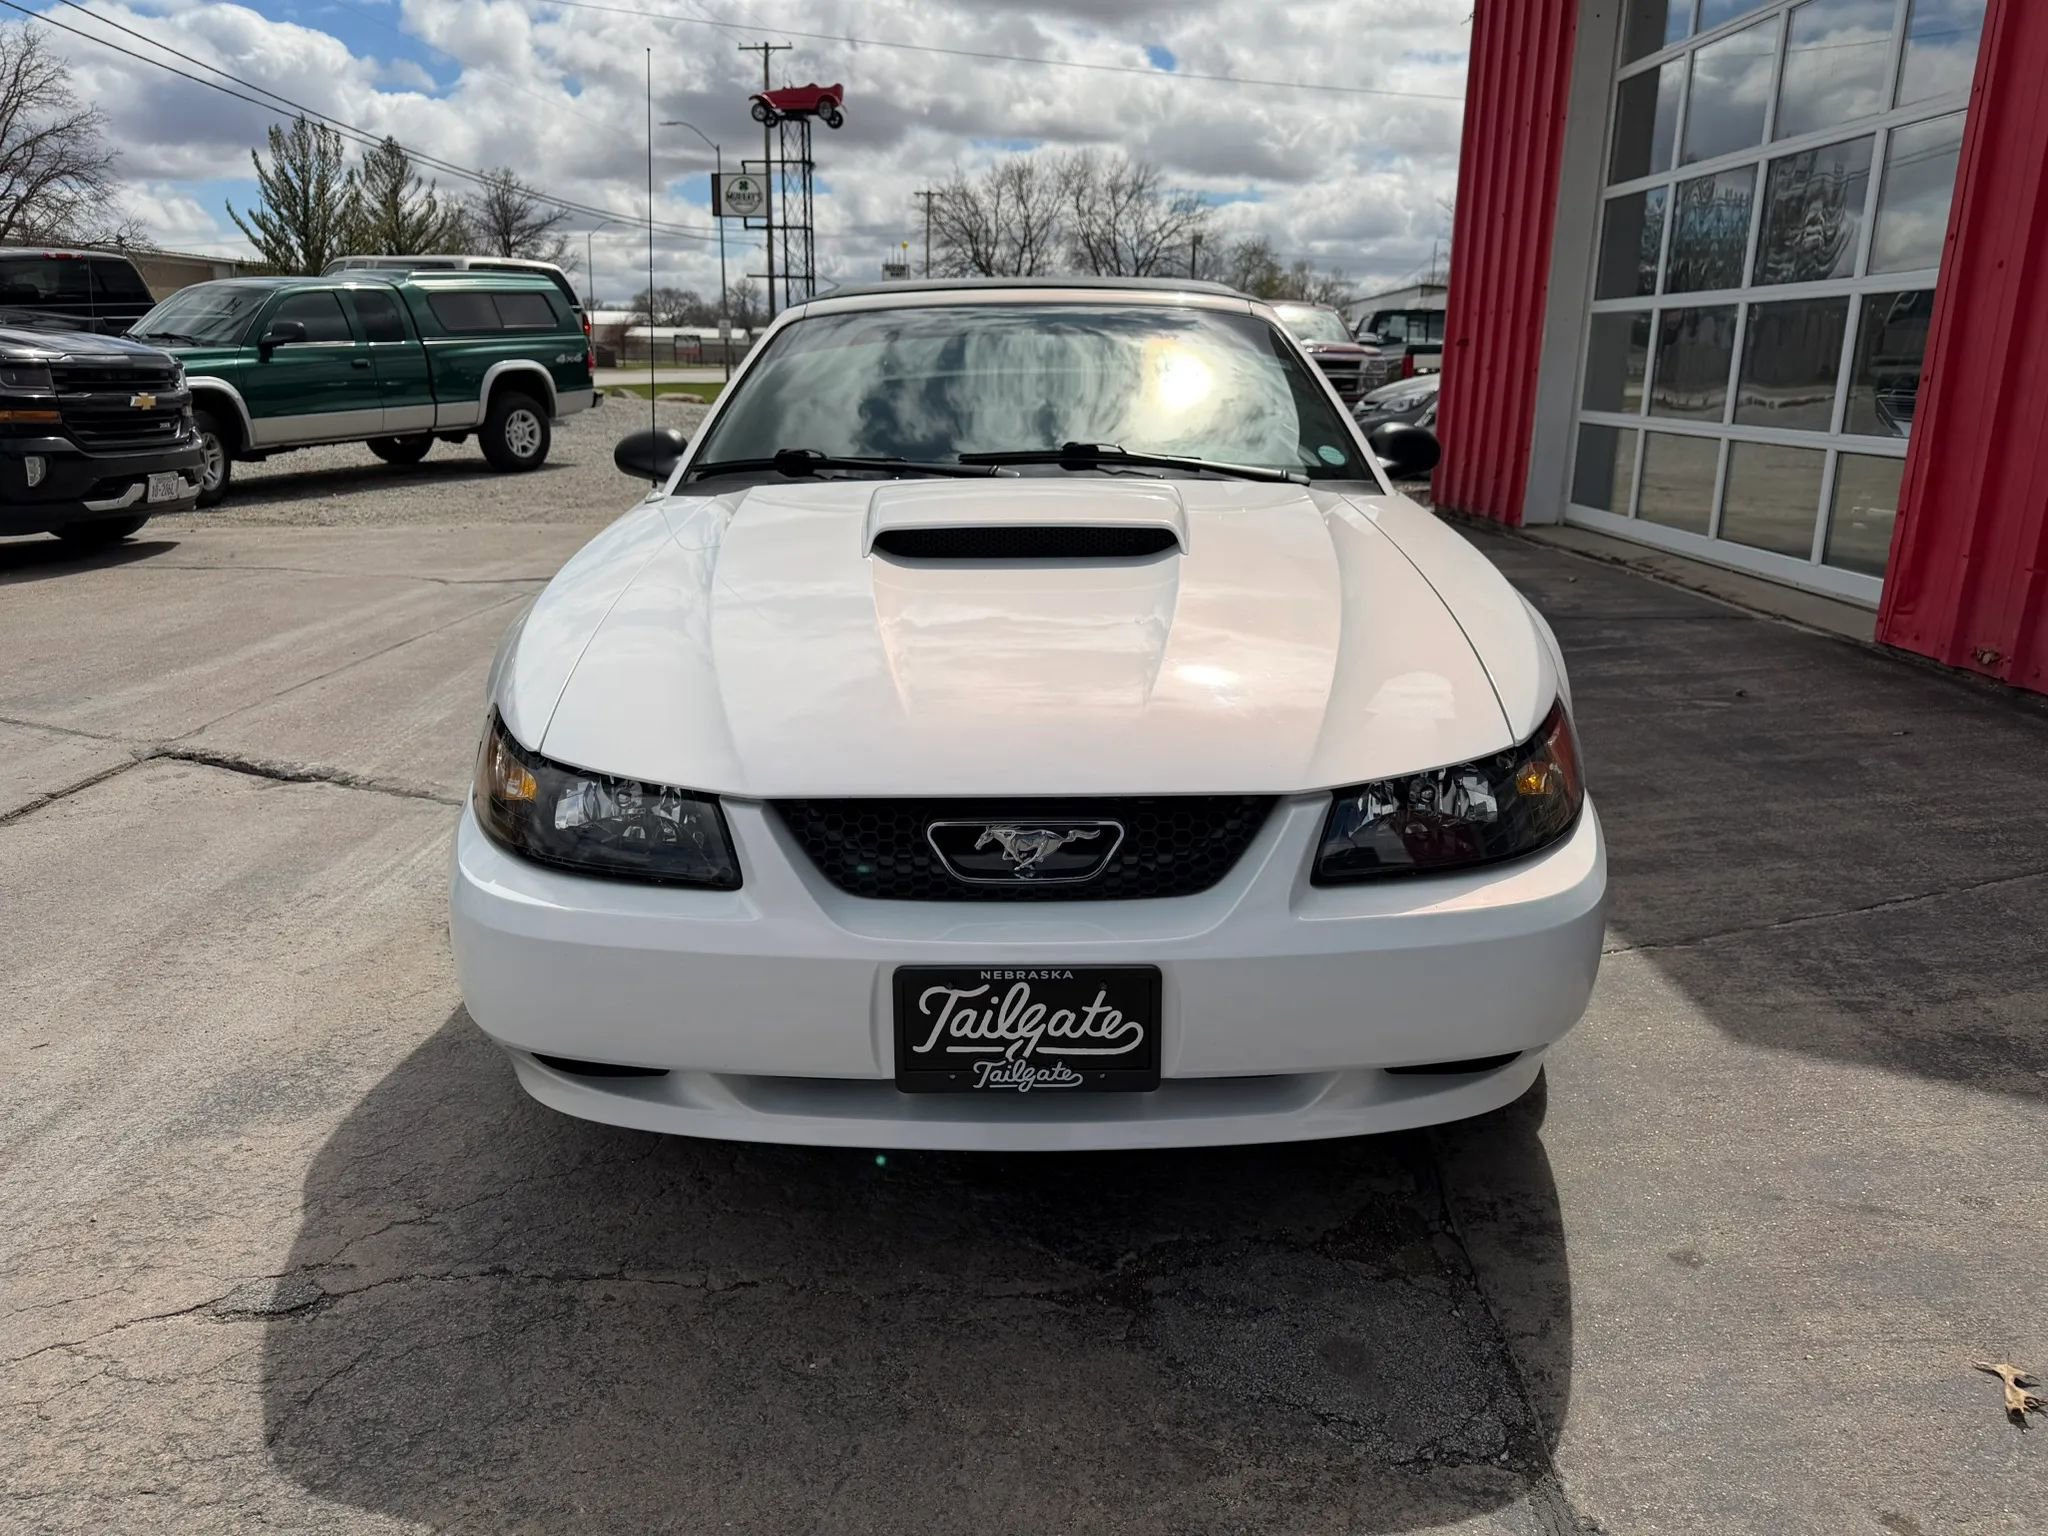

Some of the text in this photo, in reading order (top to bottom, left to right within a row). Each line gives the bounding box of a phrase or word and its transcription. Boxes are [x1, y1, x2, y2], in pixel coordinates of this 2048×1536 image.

[556, 353, 583, 364] 4x4
[980, 970, 1074, 980] NEBRASKA
[913, 982, 1144, 1060] Tailgate
[973, 1059, 1083, 1092] Tailgate
